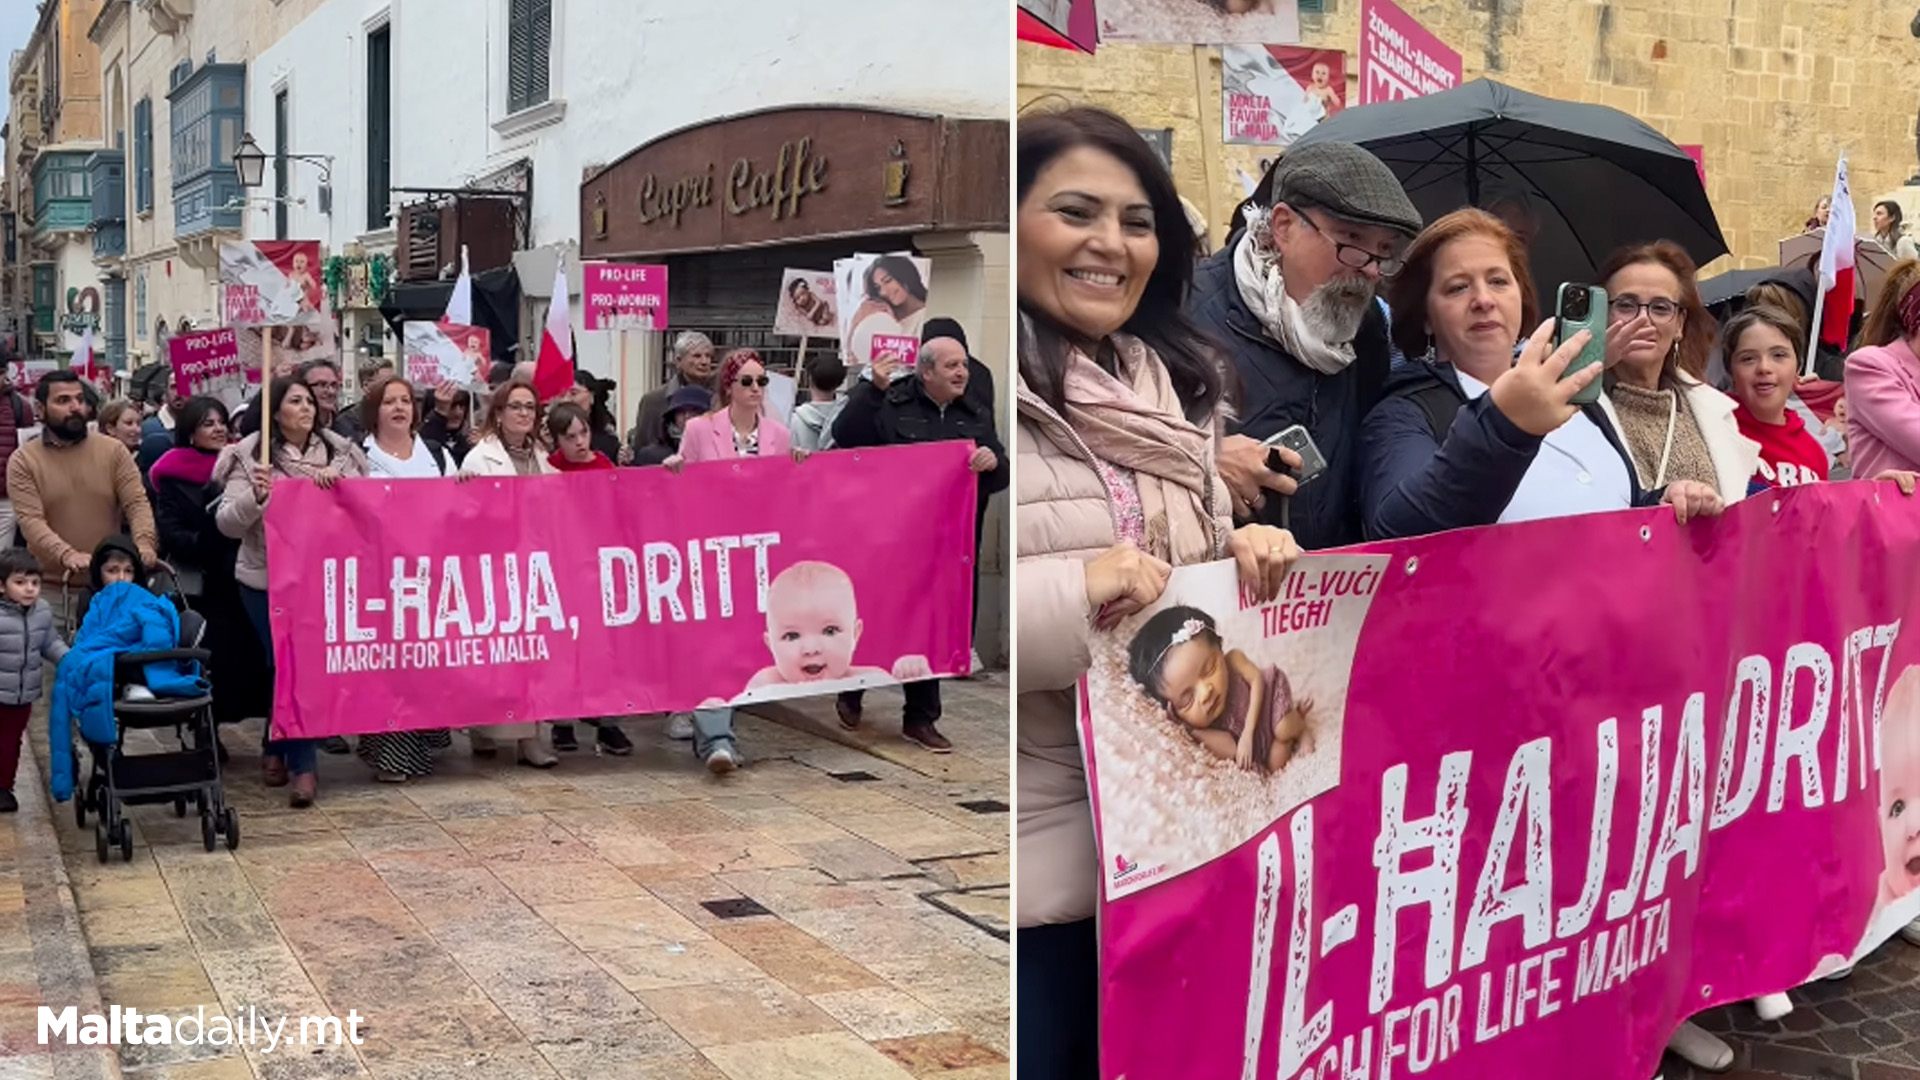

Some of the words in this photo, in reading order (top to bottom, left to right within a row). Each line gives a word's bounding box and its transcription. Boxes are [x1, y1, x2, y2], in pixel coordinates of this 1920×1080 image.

[1378, 40, 1422, 92] BARRA
[1404, 38, 1455, 90] L-ABORT
[1229, 93, 1272, 110] MALTA
[1229, 108, 1269, 124] FAVUR
[637, 163, 715, 227] Capri
[726, 136, 829, 221] Caffe
[600, 268, 647, 281] PRO-LIFE
[591, 293, 660, 307] PRO-WOMEN
[186, 331, 234, 351] PRO-LIFE
[323, 551, 579, 644] IL-ĦAJJA,
[598, 531, 781, 627] DRITT
[1260, 598, 1334, 639] TIEGĦI
[326, 641, 396, 674] MARCH
[401, 640, 440, 670] FOR
[445, 638, 485, 668] LIFE
[489, 634, 550, 665] MALTA
[1241, 692, 1705, 1080] IL-ĦAJJA
[1708, 617, 1902, 832] DRITT
[1379, 984, 1463, 1080] FOR
[1475, 946, 1568, 1044] LIFE
[1572, 898, 1672, 1005] MALTA
